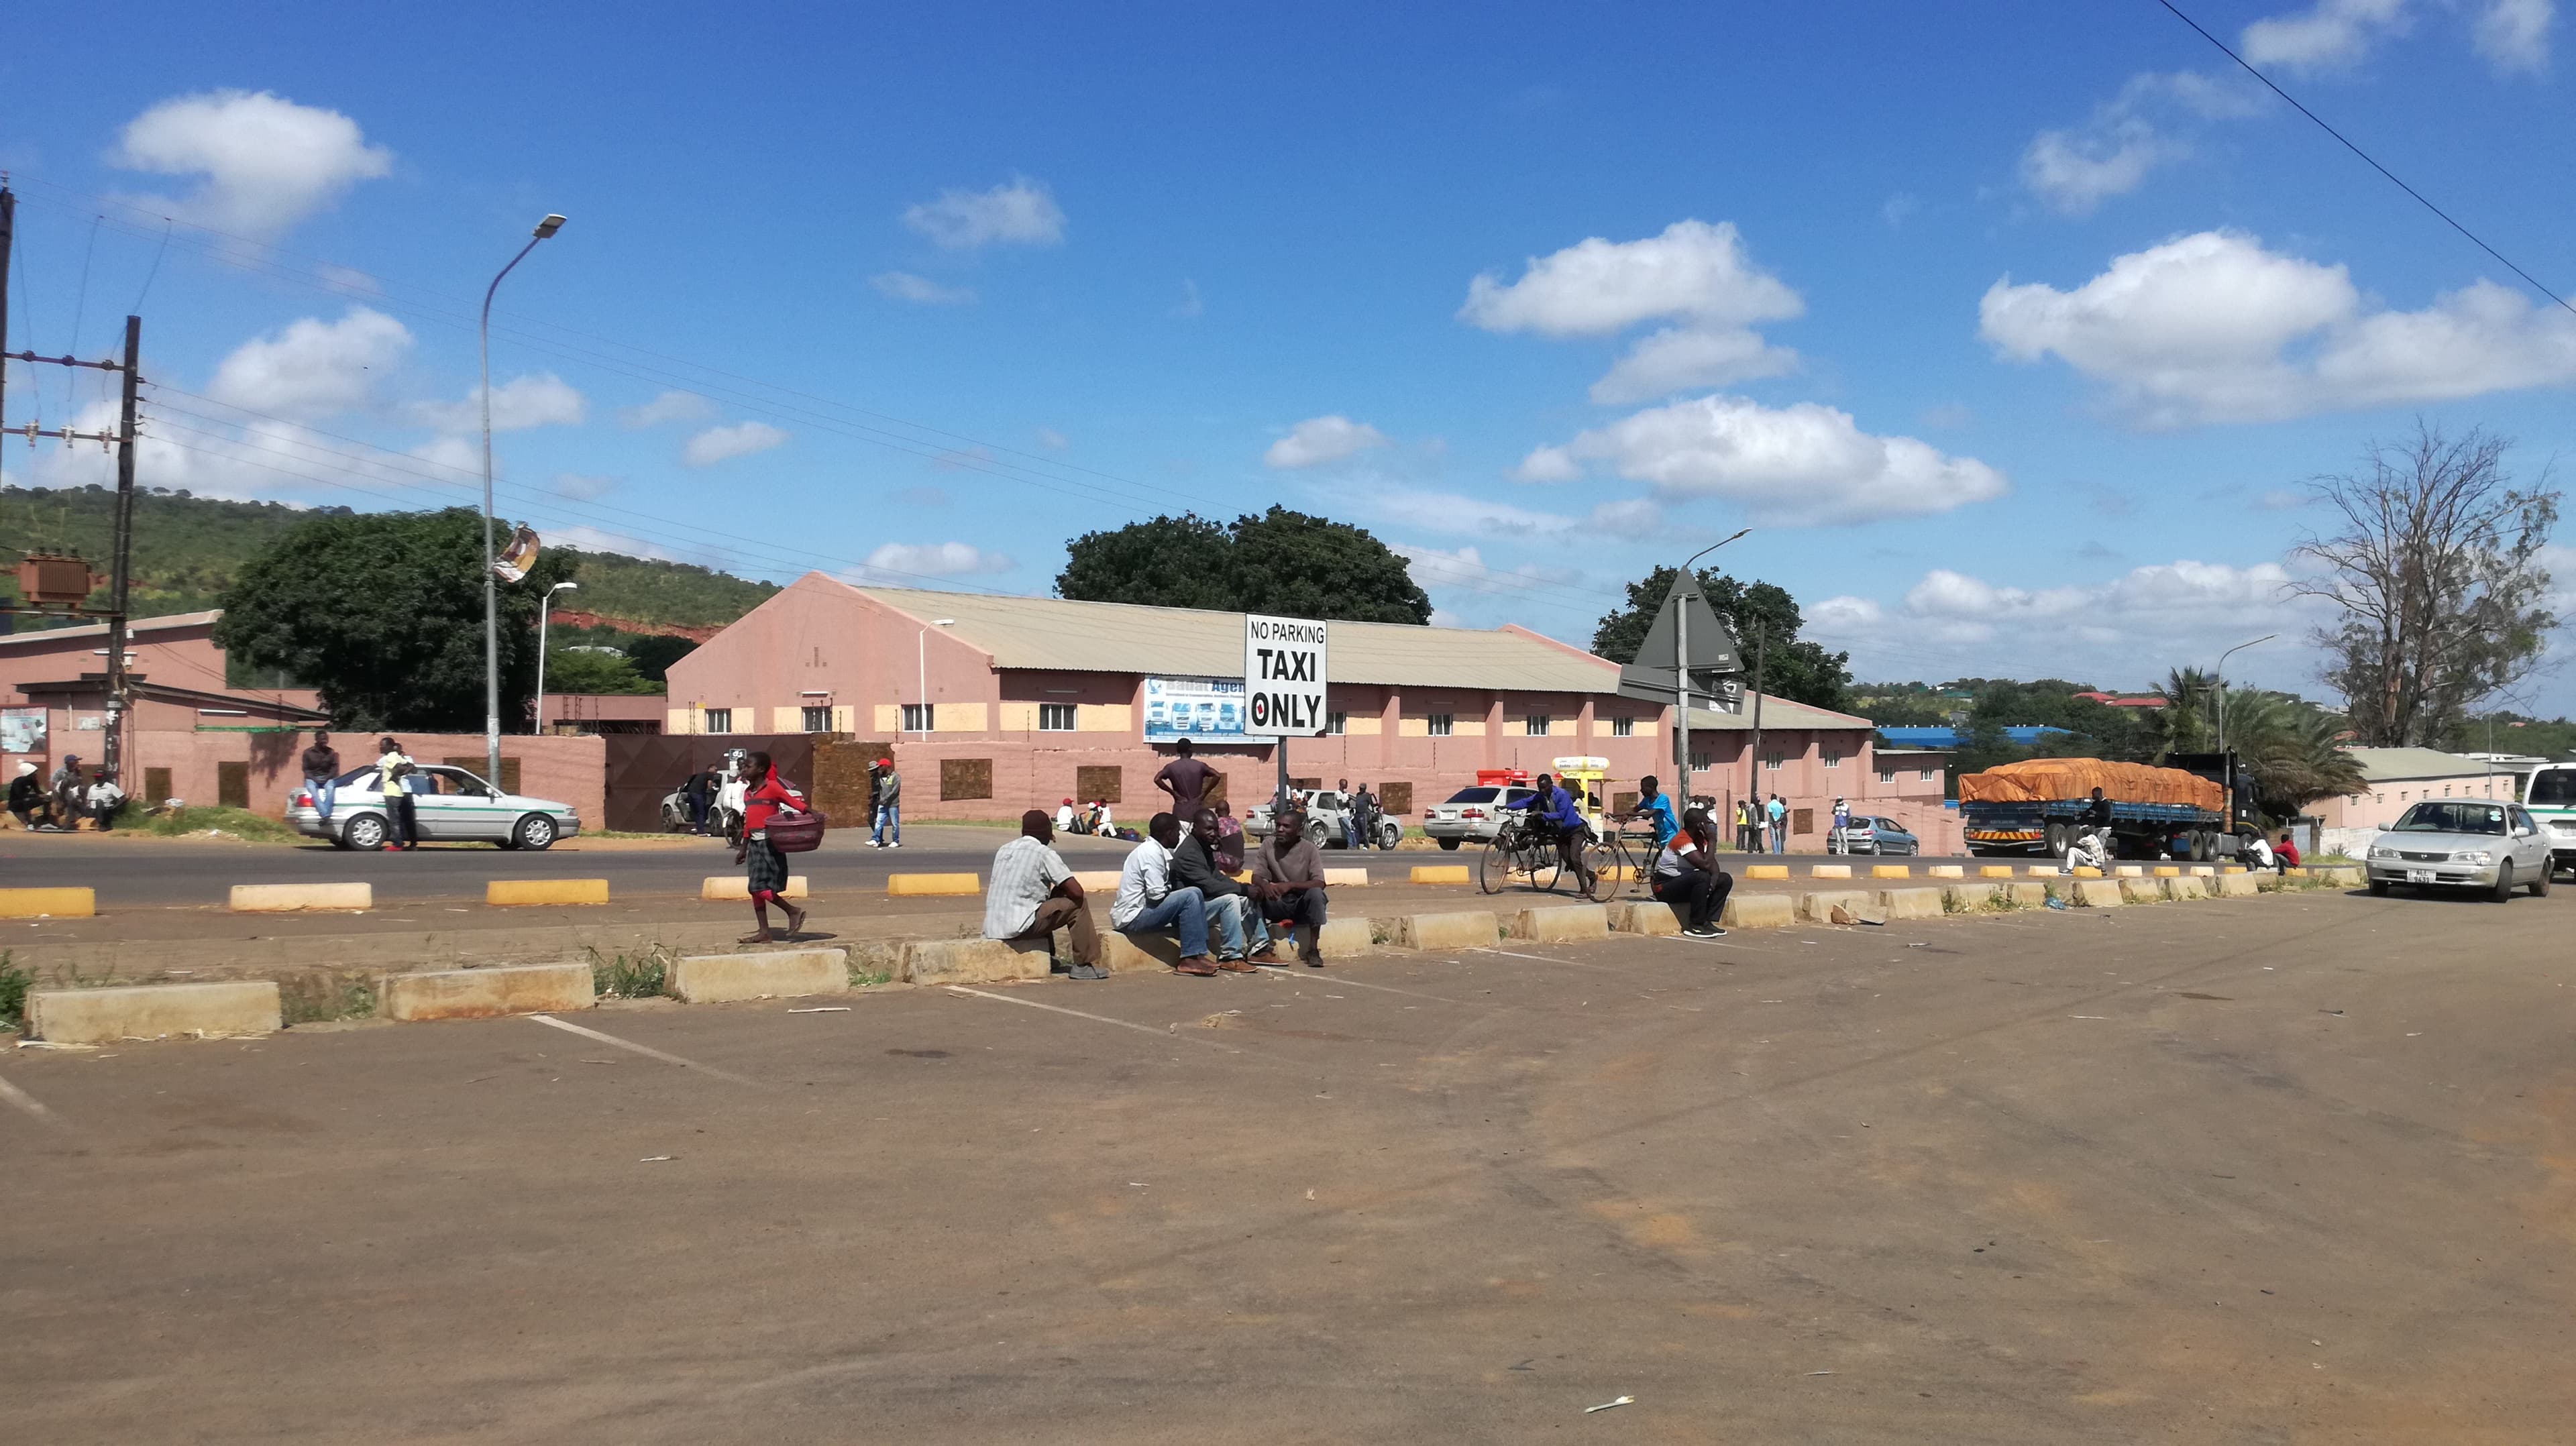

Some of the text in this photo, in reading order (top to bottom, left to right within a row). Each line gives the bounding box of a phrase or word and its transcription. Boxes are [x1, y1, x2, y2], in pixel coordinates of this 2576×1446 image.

[1251, 621, 1324, 644] NO PARKING
[1257, 649, 1316, 682] TAXI
[1212, 680, 1245, 693] Agen
[1251, 692, 1322, 728] ONLY
